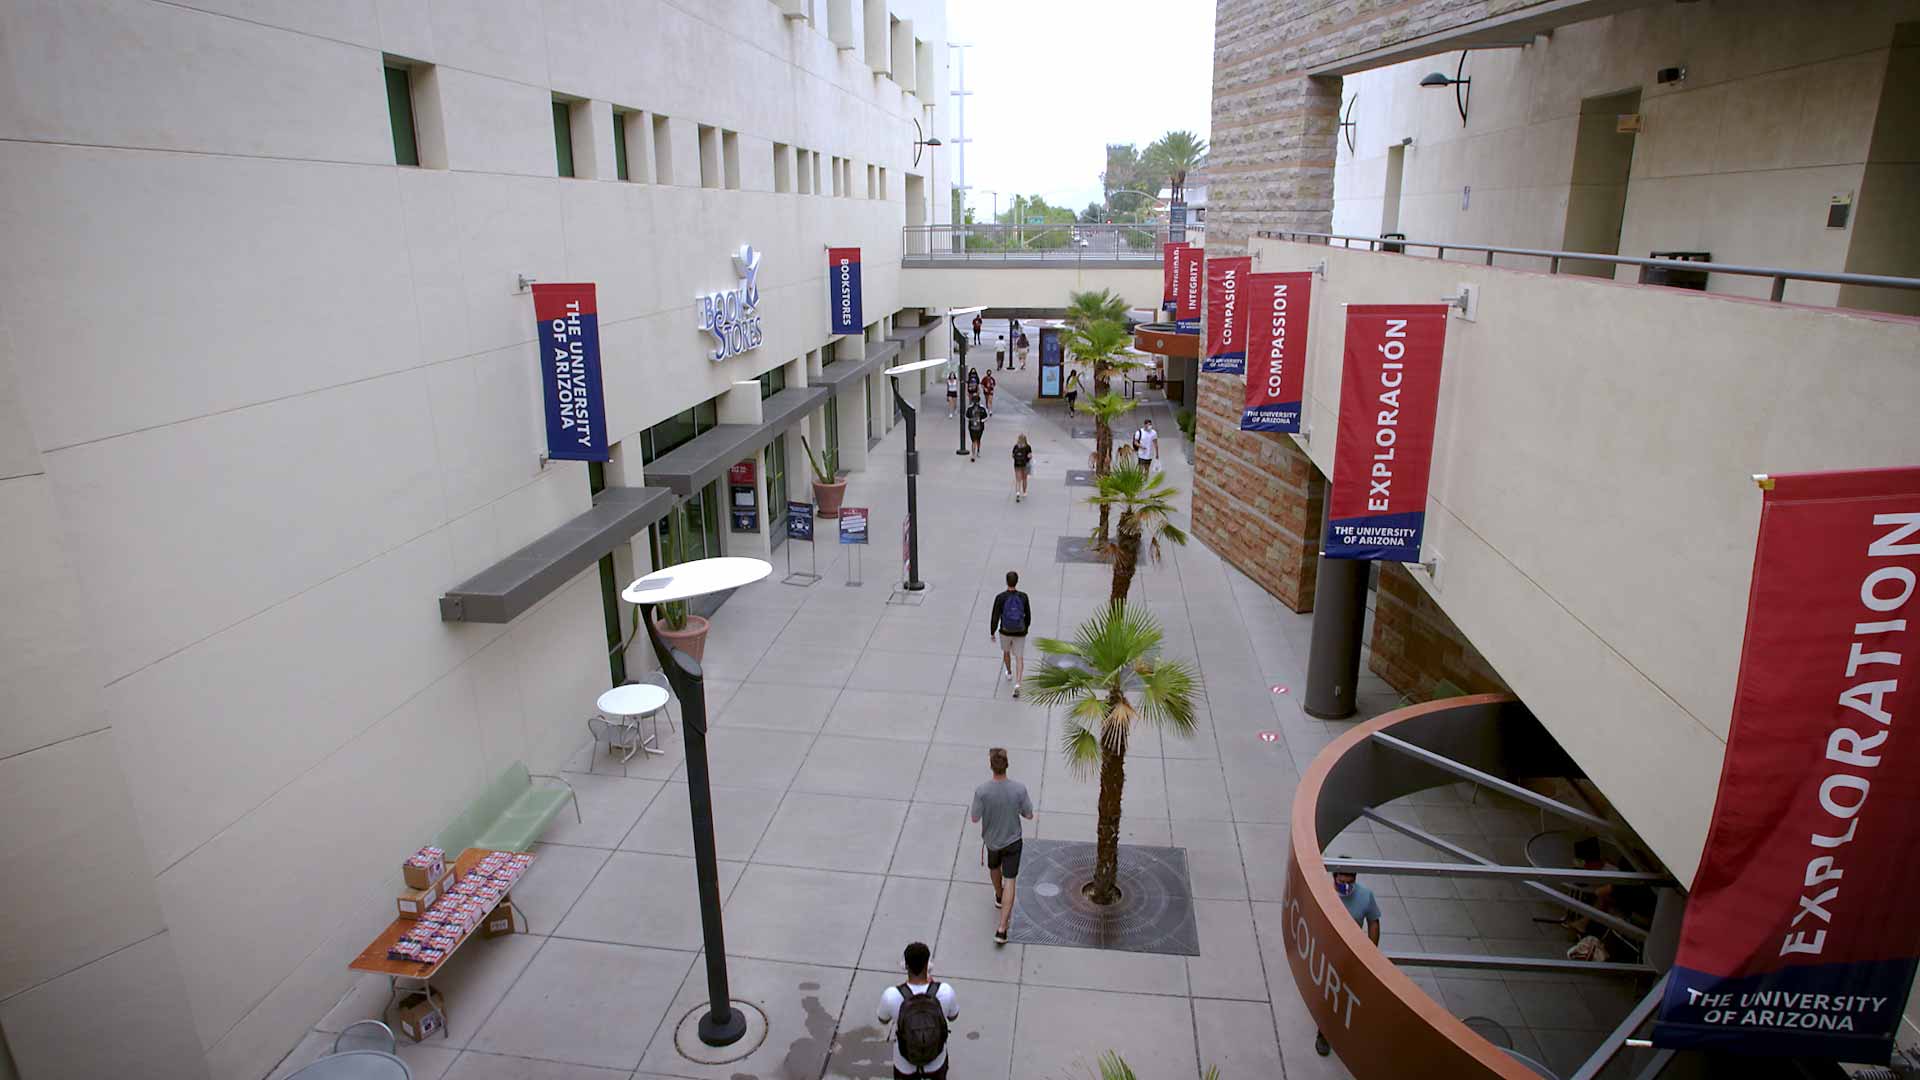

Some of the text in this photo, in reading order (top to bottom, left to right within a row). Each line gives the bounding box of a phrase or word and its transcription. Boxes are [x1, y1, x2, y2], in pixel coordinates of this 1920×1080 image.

[704, 290, 745, 329] BOOK
[840, 258, 851, 326] BOOKSTORES
[1188, 260, 1199, 310] INTEGRITY
[1222, 270, 1236, 345] COMPASIÓN
[714, 311, 763, 360] STORES
[1268, 283, 1287, 398] COMPASSION
[552, 318, 575, 430] OF ARIZONA
[566, 300, 592, 447] THE UNIVERSITY
[1260, 411, 1298, 419] UNIVERSITY
[1367, 318, 1408, 512] EXPLORACIÓN
[1334, 526, 1416, 537] THE UNIVERSITY
[1343, 535, 1405, 546] OF ARIZONA
[1779, 512, 1920, 957] EXPLORATION
[1290, 900, 1361, 1030] COURT
[1687, 987, 1888, 1013] THE UNIVERSITY
[1703, 1010, 1854, 1031] OF ARIZONA
